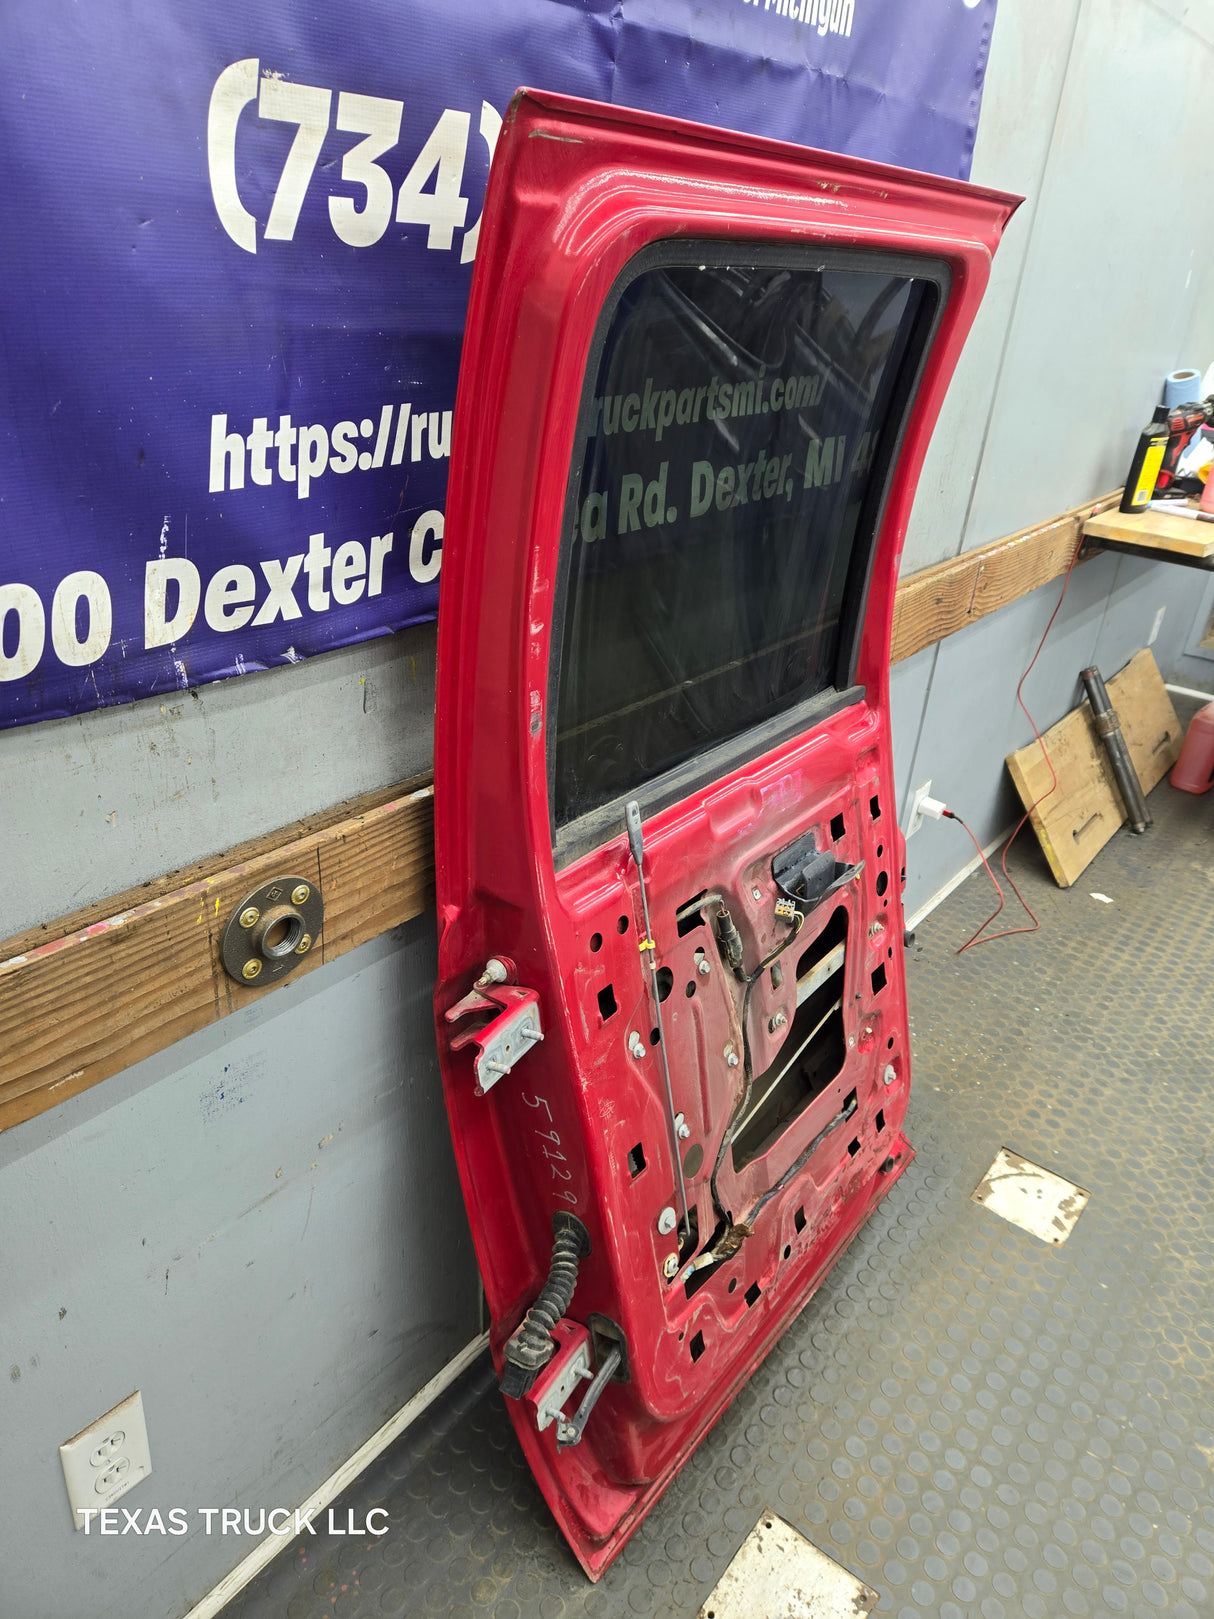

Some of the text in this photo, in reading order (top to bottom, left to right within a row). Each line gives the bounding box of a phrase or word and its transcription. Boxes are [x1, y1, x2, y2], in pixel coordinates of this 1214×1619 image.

[209, 403, 453, 499] https://ru
[145, 533, 394, 649] Dexter
[618, 461, 677, 534] Rd.
[690, 450, 793, 518] Dexter,
[803, 435, 847, 489] MI
